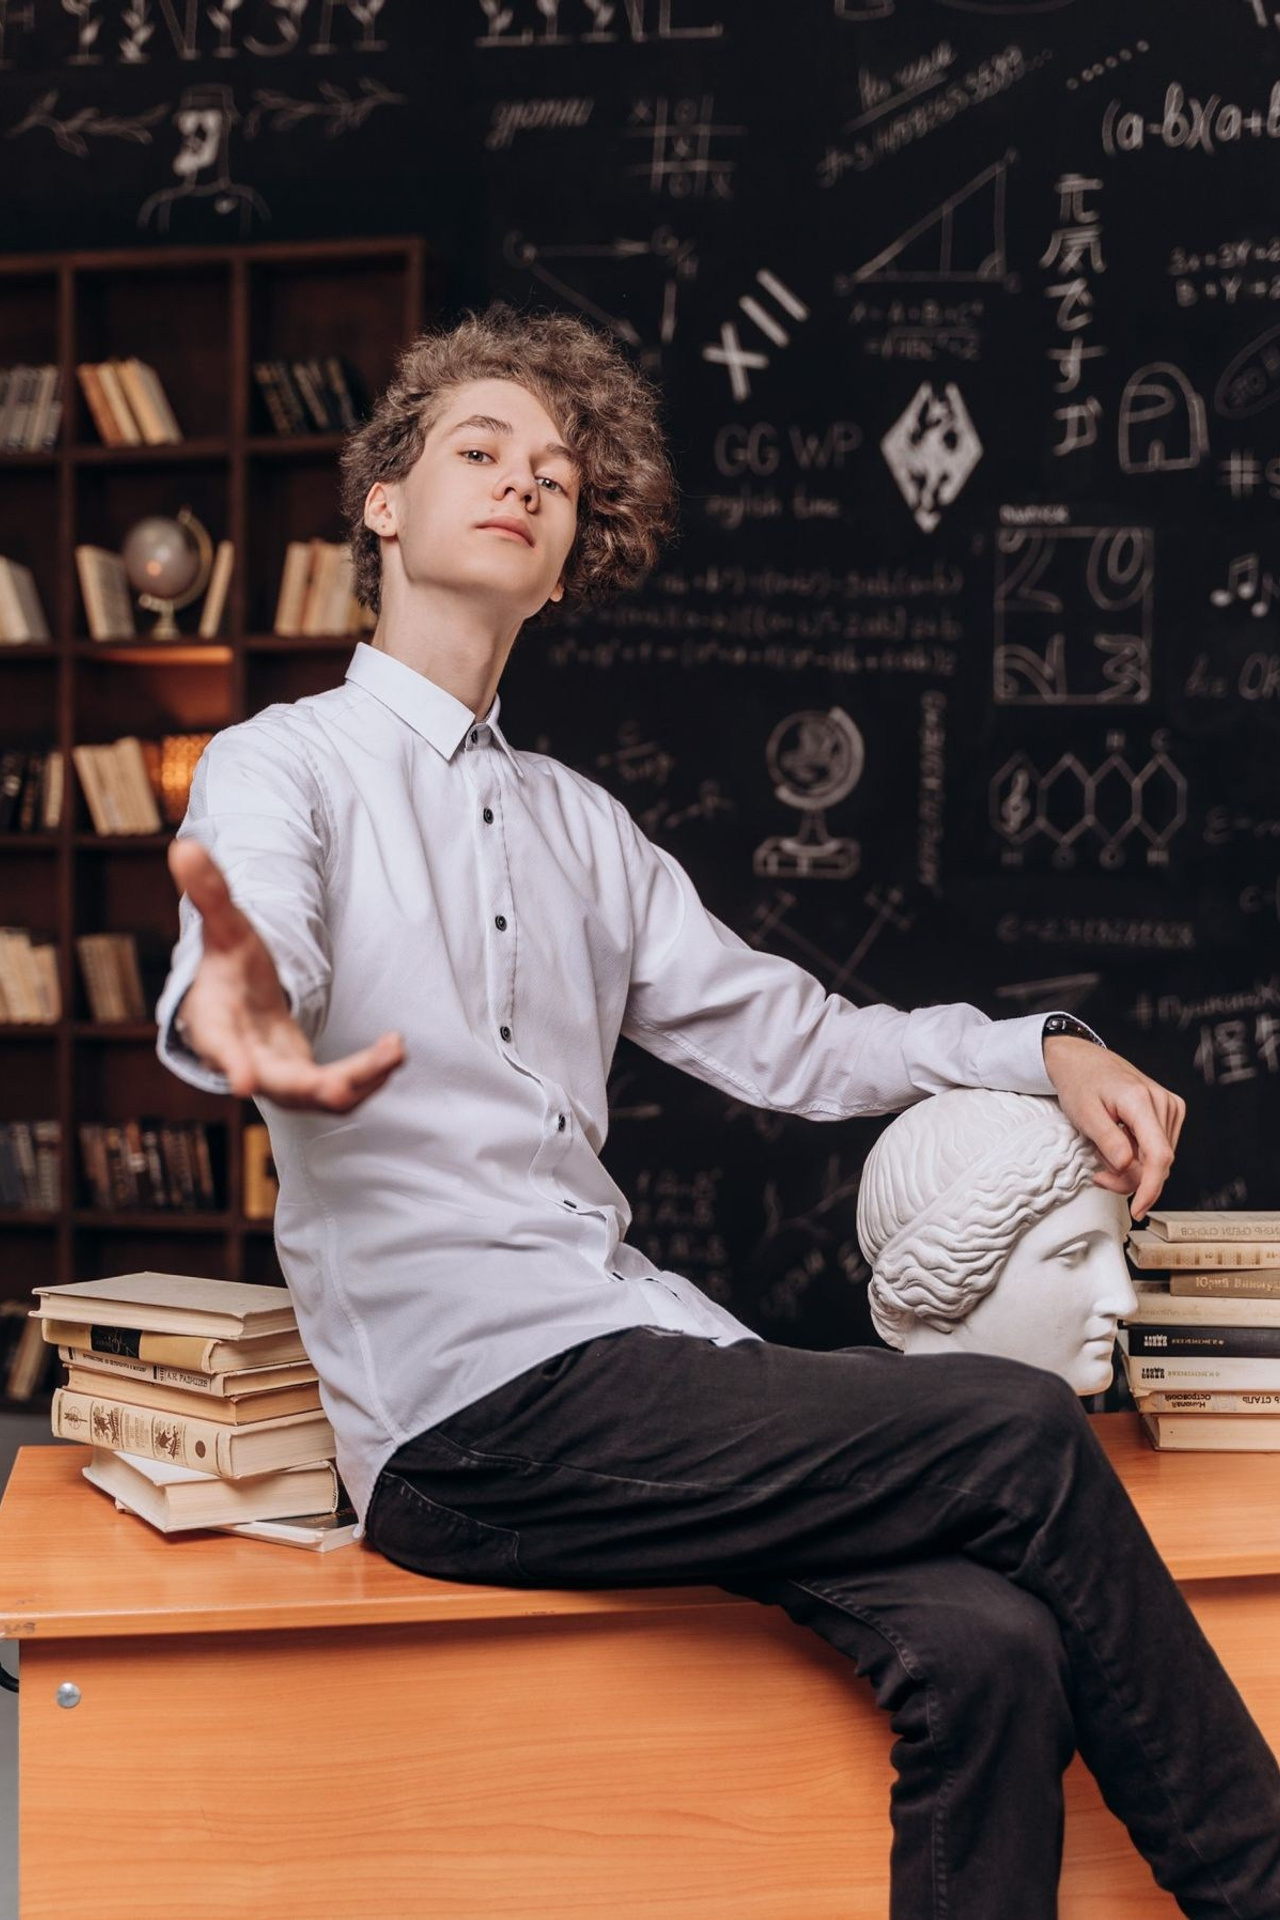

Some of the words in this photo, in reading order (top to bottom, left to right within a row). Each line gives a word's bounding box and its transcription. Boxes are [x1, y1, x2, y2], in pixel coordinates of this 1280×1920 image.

[713, 421, 780, 477] GG
[788, 420, 865, 471] WP
[1195, 1276, 1230, 1291] Юрий
[1242, 1396, 1272, 1404] СТАЛЬ
